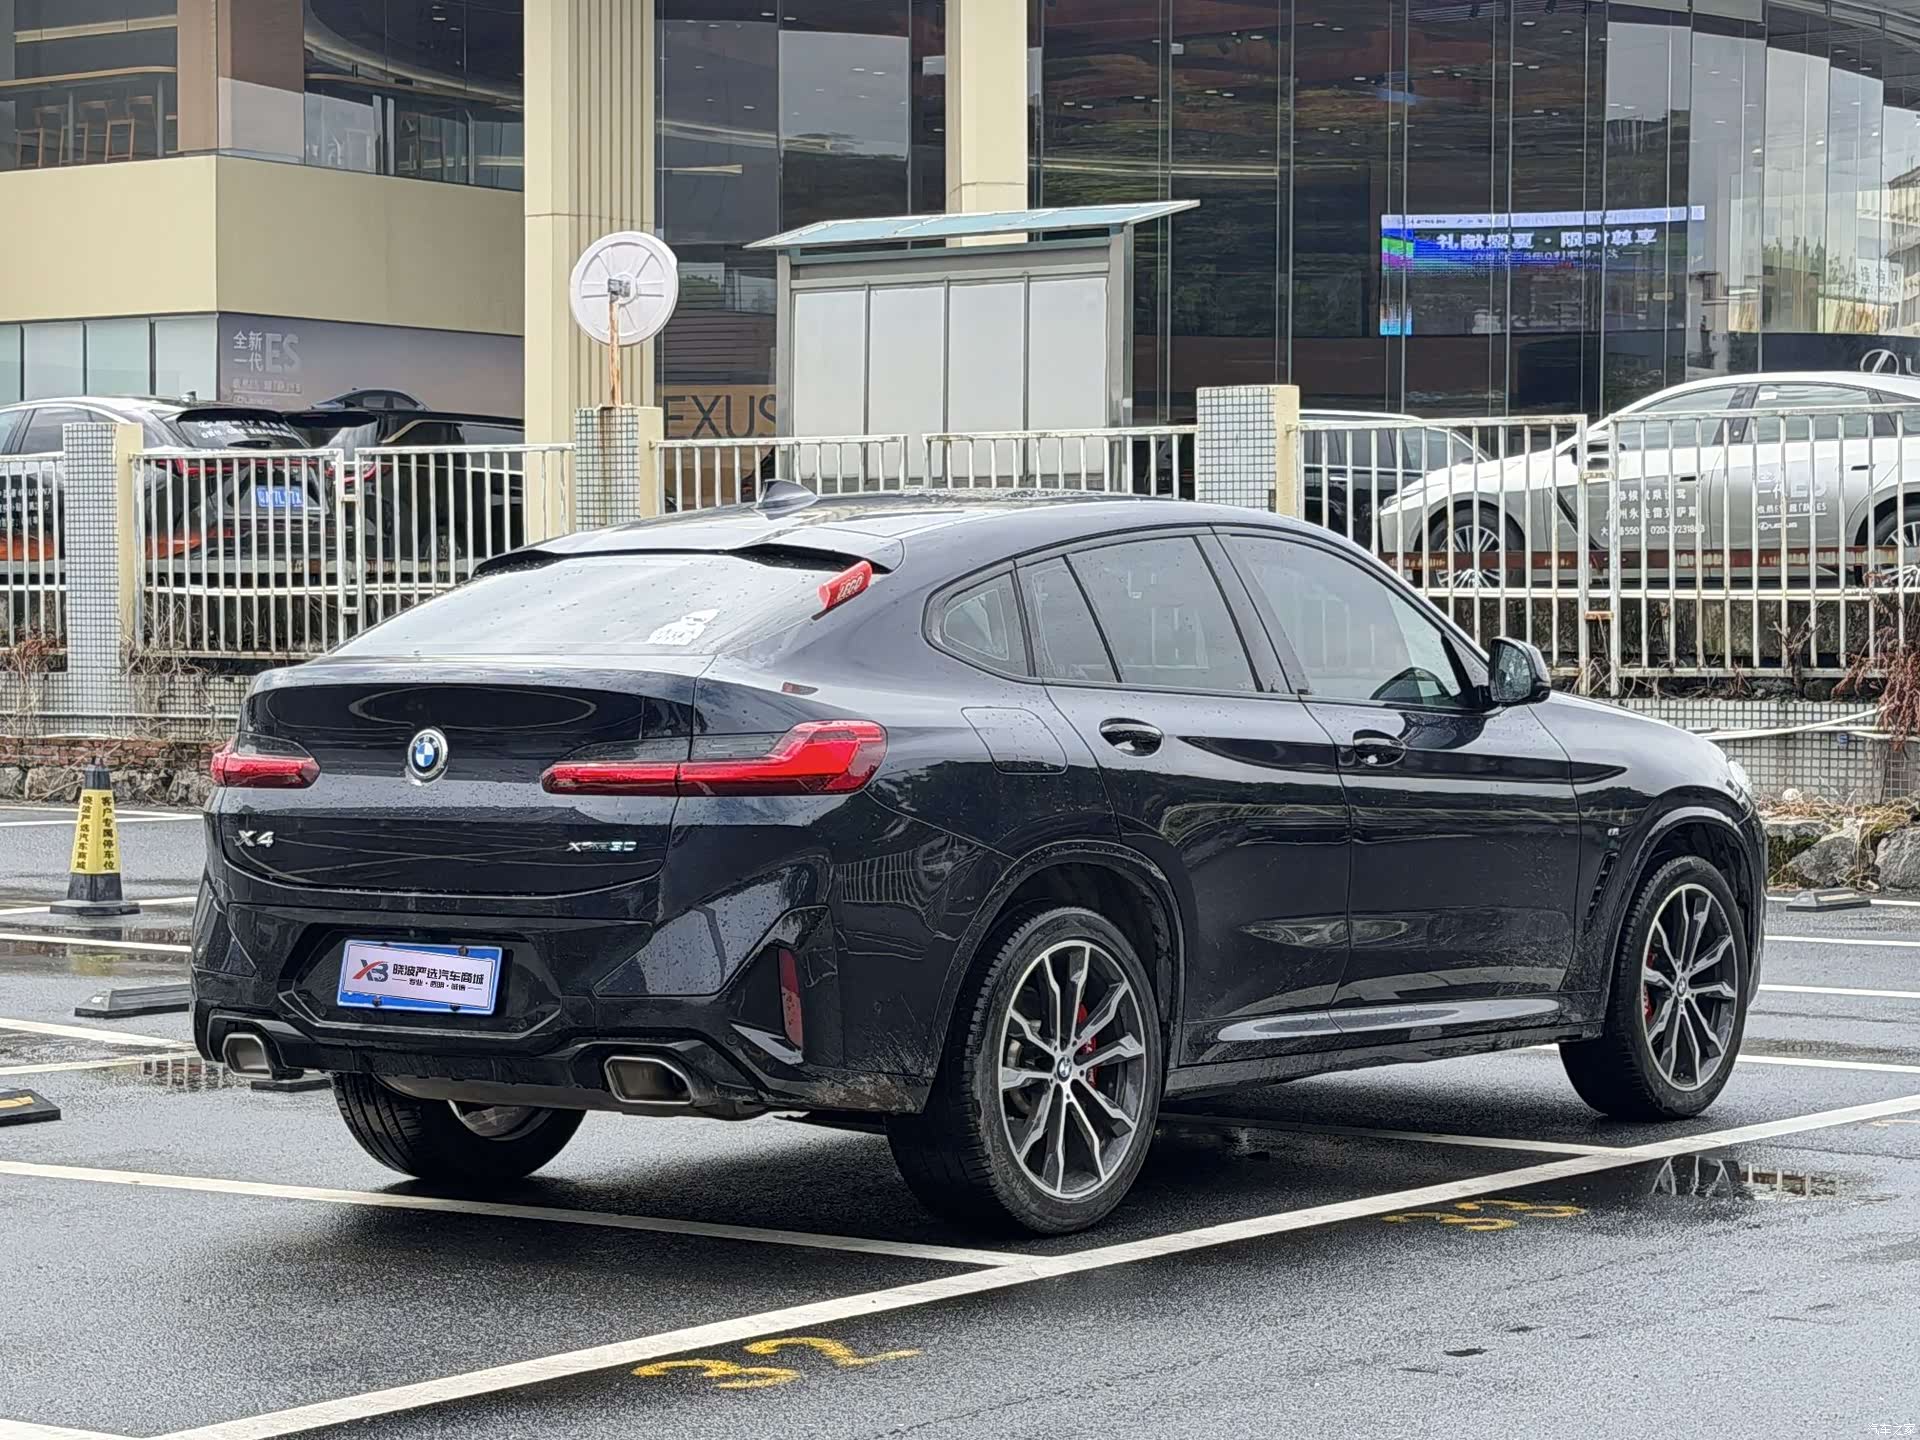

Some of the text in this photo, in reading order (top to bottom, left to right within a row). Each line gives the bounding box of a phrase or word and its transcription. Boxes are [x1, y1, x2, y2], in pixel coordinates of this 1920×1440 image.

[233, 331, 262, 351] 全新
[233, 352, 263, 372] 一代
[265, 333, 301, 373] ES
[101, 796, 115, 870] 客户专属停车位
[235, 830, 274, 847] X4
[392, 963, 484, 985] 晓波严选汽车商城
[631, 1336, 921, 1390] 32
